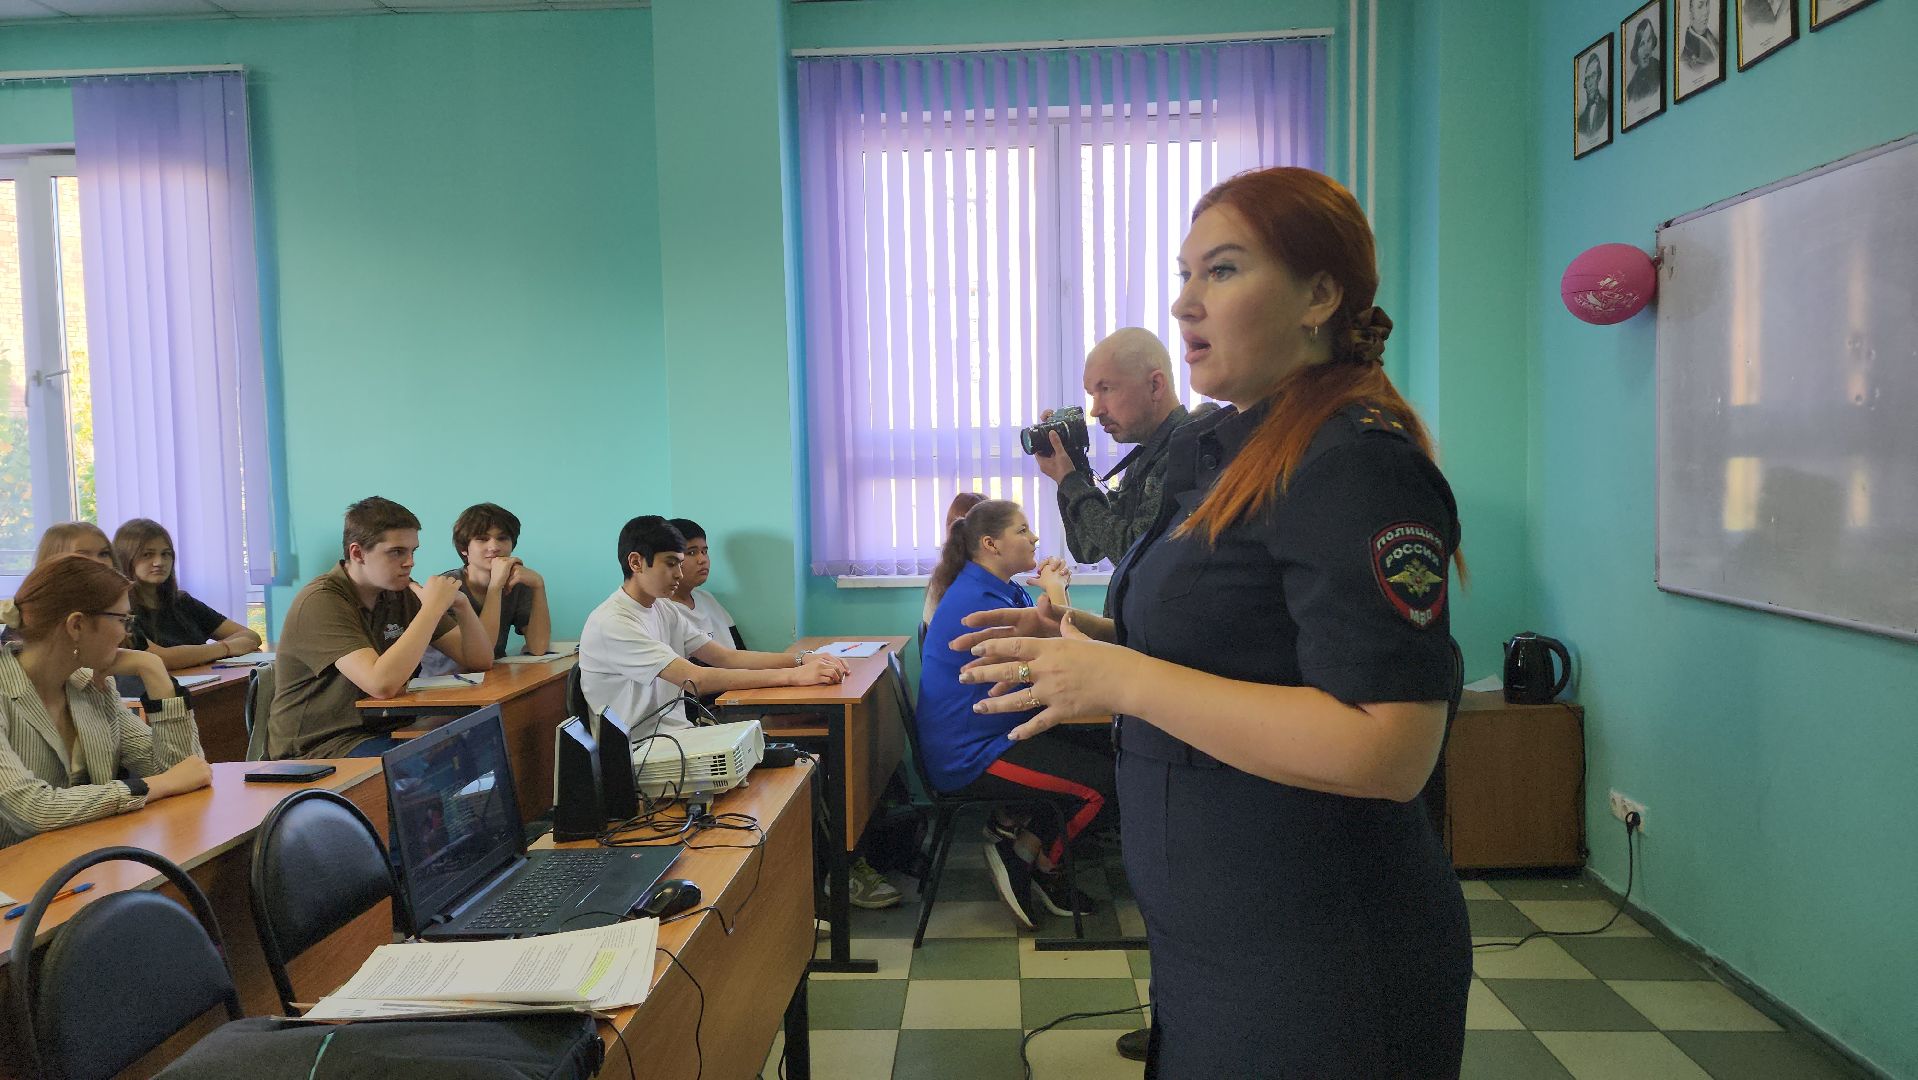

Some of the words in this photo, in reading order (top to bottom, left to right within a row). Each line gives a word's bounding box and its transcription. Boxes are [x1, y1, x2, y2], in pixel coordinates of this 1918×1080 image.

[1376, 526, 1442, 550] ПОЛИЦИЯ
[1385, 543, 1439, 568] РОССИЯ
[1409, 609, 1432, 625] МВД
